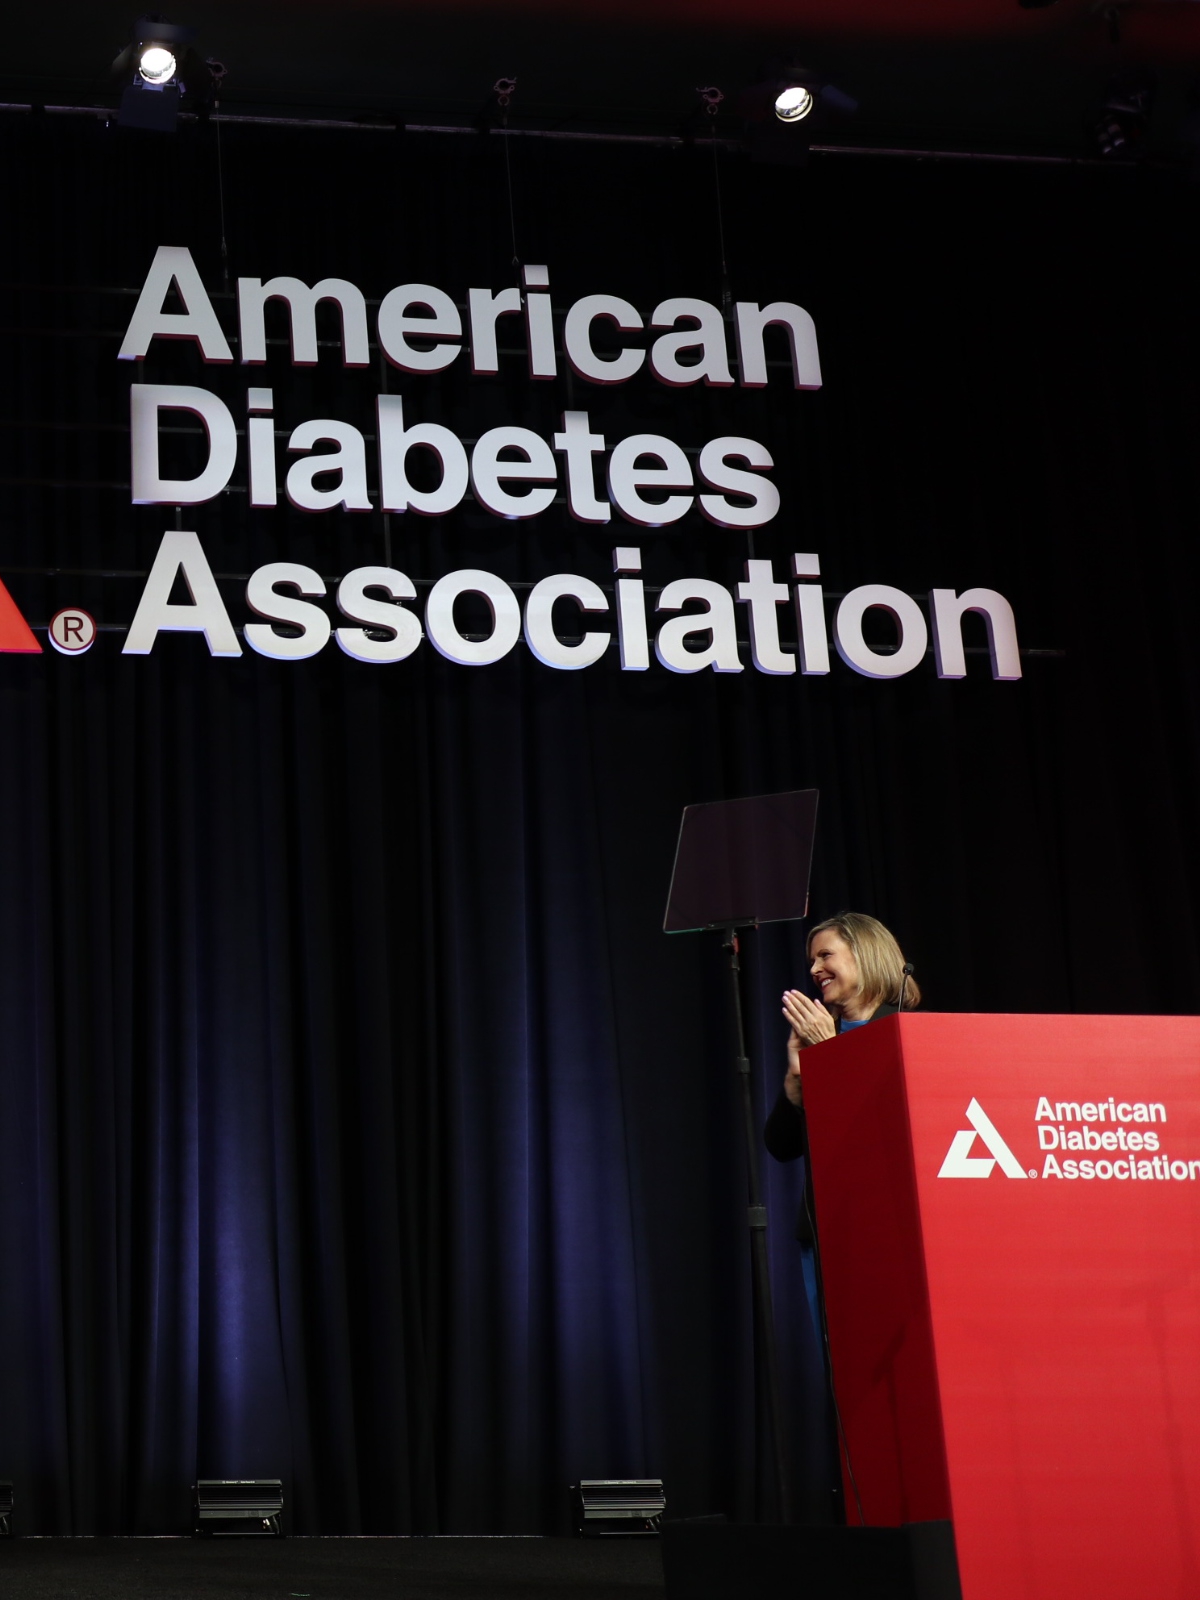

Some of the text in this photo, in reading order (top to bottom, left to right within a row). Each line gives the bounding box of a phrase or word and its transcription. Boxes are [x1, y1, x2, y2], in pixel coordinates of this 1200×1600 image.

[118, 245, 823, 390] American
[130, 383, 781, 530] Diabetes
[120, 530, 1023, 681] Association
[1034, 1096, 1167, 1123] American
[1037, 1125, 1160, 1151] Diabetes
